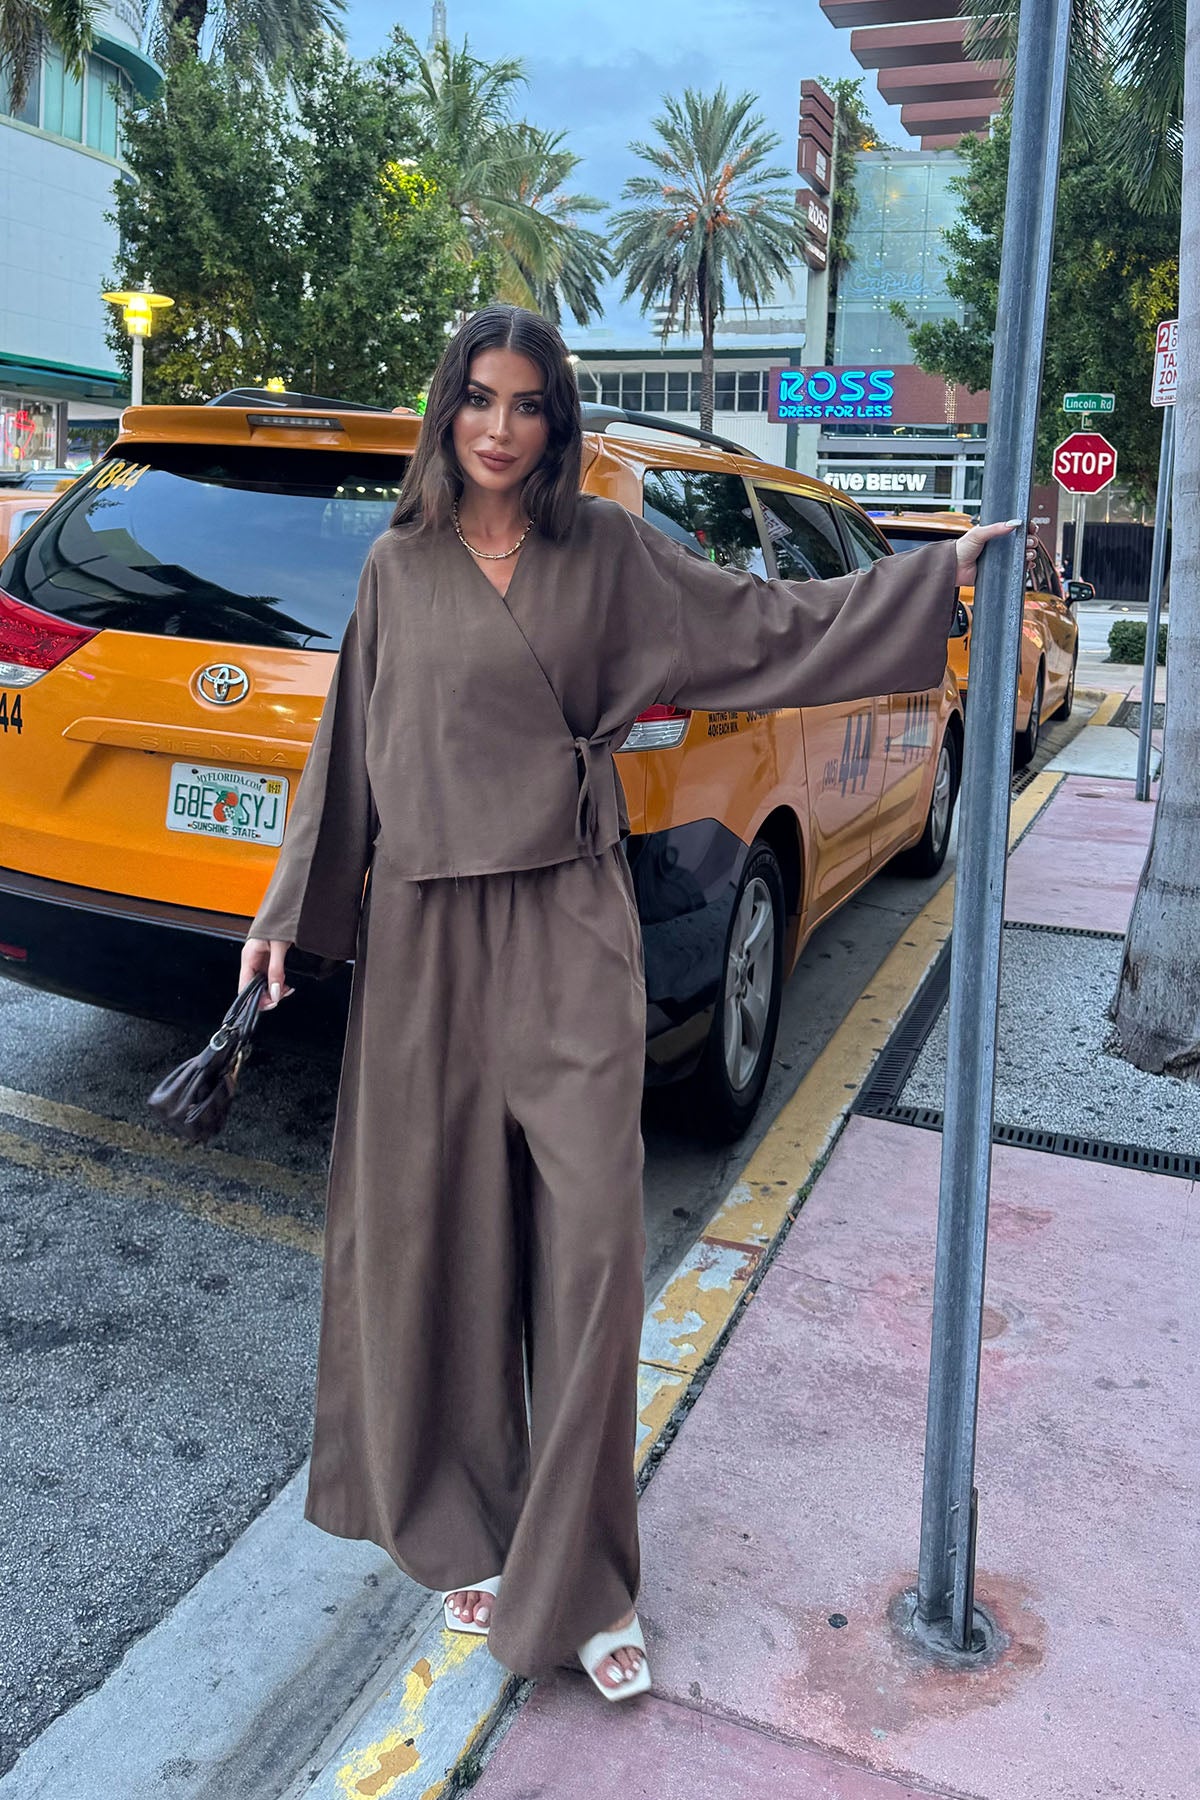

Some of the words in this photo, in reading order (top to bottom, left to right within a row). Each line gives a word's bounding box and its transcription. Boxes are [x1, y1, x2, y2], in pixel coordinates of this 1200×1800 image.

[808, 199, 828, 234] ROSS
[1160, 326, 1169, 348] 2
[1163, 353, 1177, 368] TA
[780, 370, 895, 402] ROSS
[779, 405, 822, 418] DRESS
[825, 405, 854, 418] FOR
[857, 405, 893, 418] LESS
[1066, 399, 1097, 409] Lincoln
[1100, 399, 1112, 409] Rd
[1057, 451, 1112, 475] STOP
[88, 461, 152, 492] 1844
[708, 711, 728, 723] WAITING
[139, 735, 289, 763] SIENNA
[174, 783, 216, 820] 68E
[237, 793, 279, 830] SYJ
[191, 820, 229, 835] SUNSHINE
[231, 826, 257, 839] STATE
